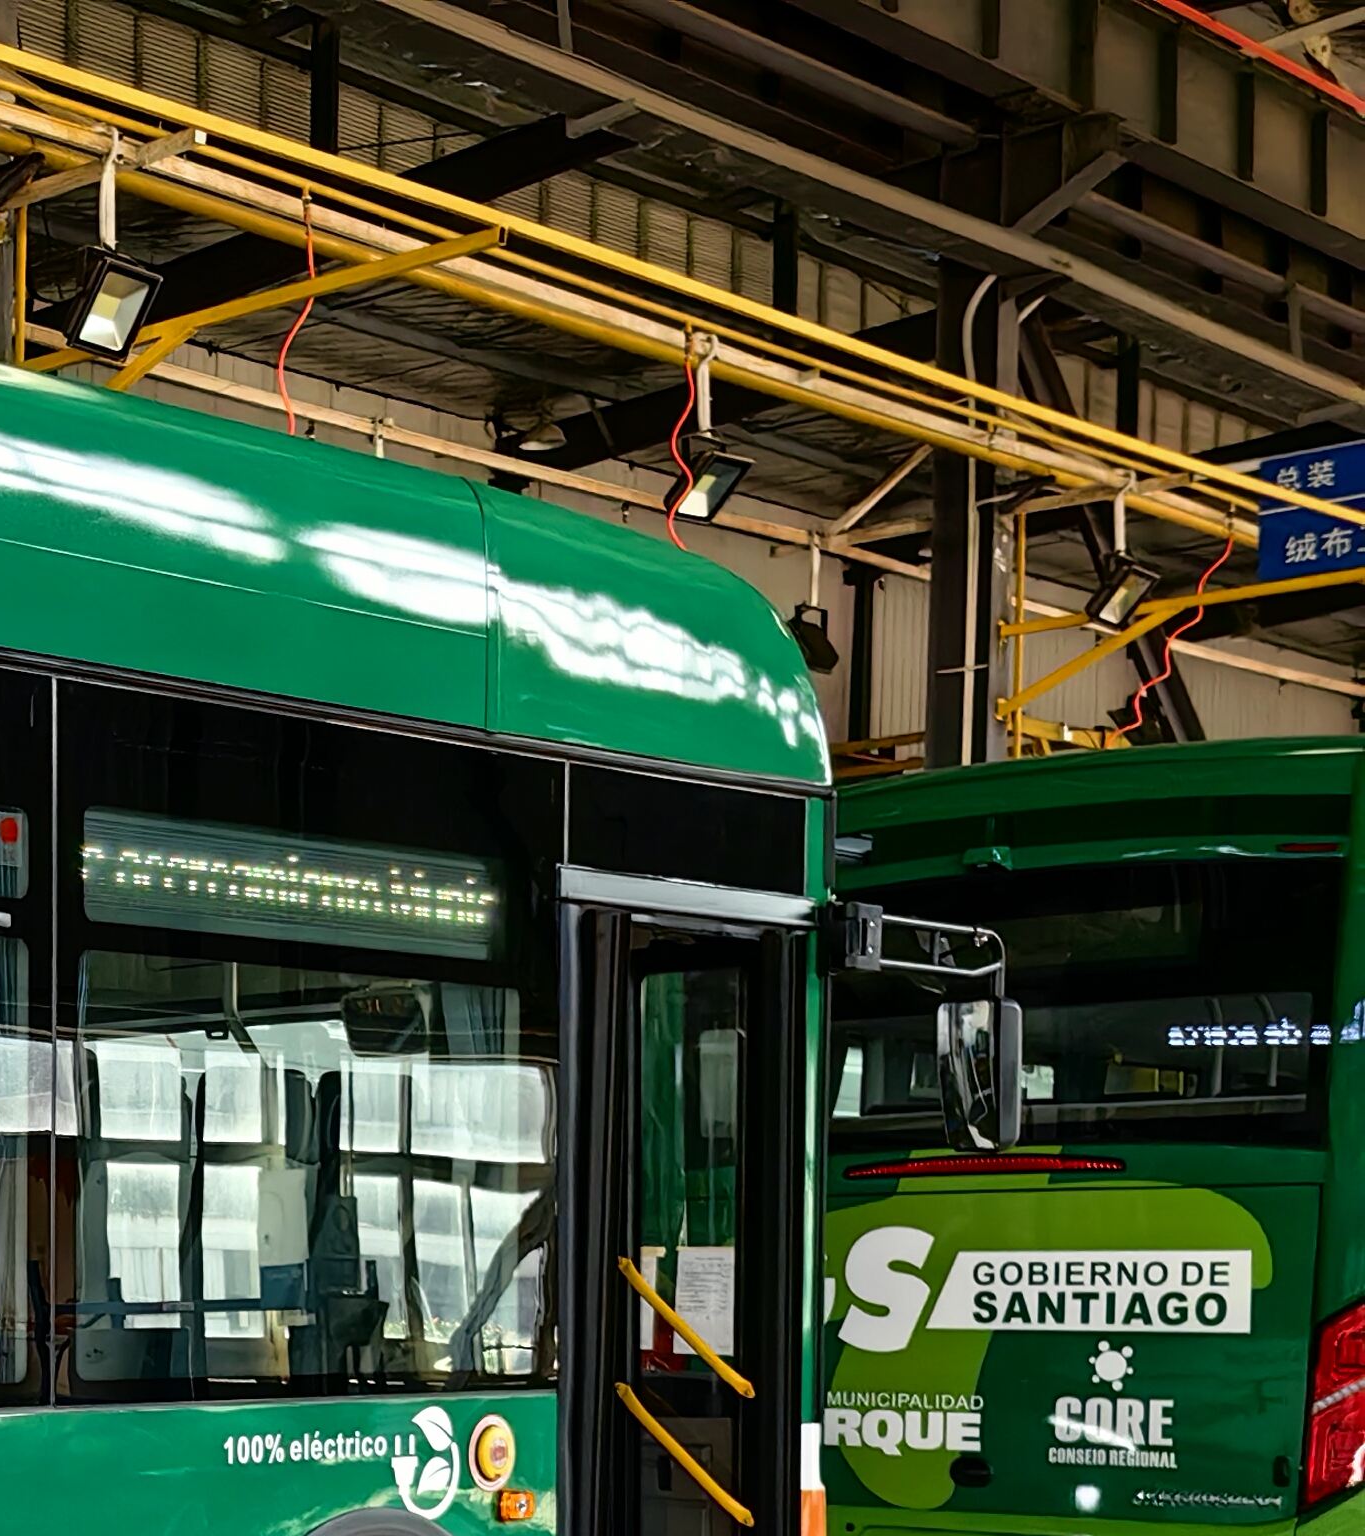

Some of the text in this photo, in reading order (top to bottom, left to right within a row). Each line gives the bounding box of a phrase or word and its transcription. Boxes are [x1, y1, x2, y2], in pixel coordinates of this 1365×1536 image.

[1277, 460, 1335, 490] 总装
[824, 1226, 935, 1352] S
[972, 1261, 1230, 1286] GOBIERNO DE
[972, 1291, 1227, 1326] SANTIAGO
[826, 1391, 984, 1411] MUNICIPALIDAD
[1054, 1396, 1174, 1446] CORE
[223, 1430, 388, 1464] 100% eléctrico
[1108, 1448, 1178, 1469] REGIONAL
